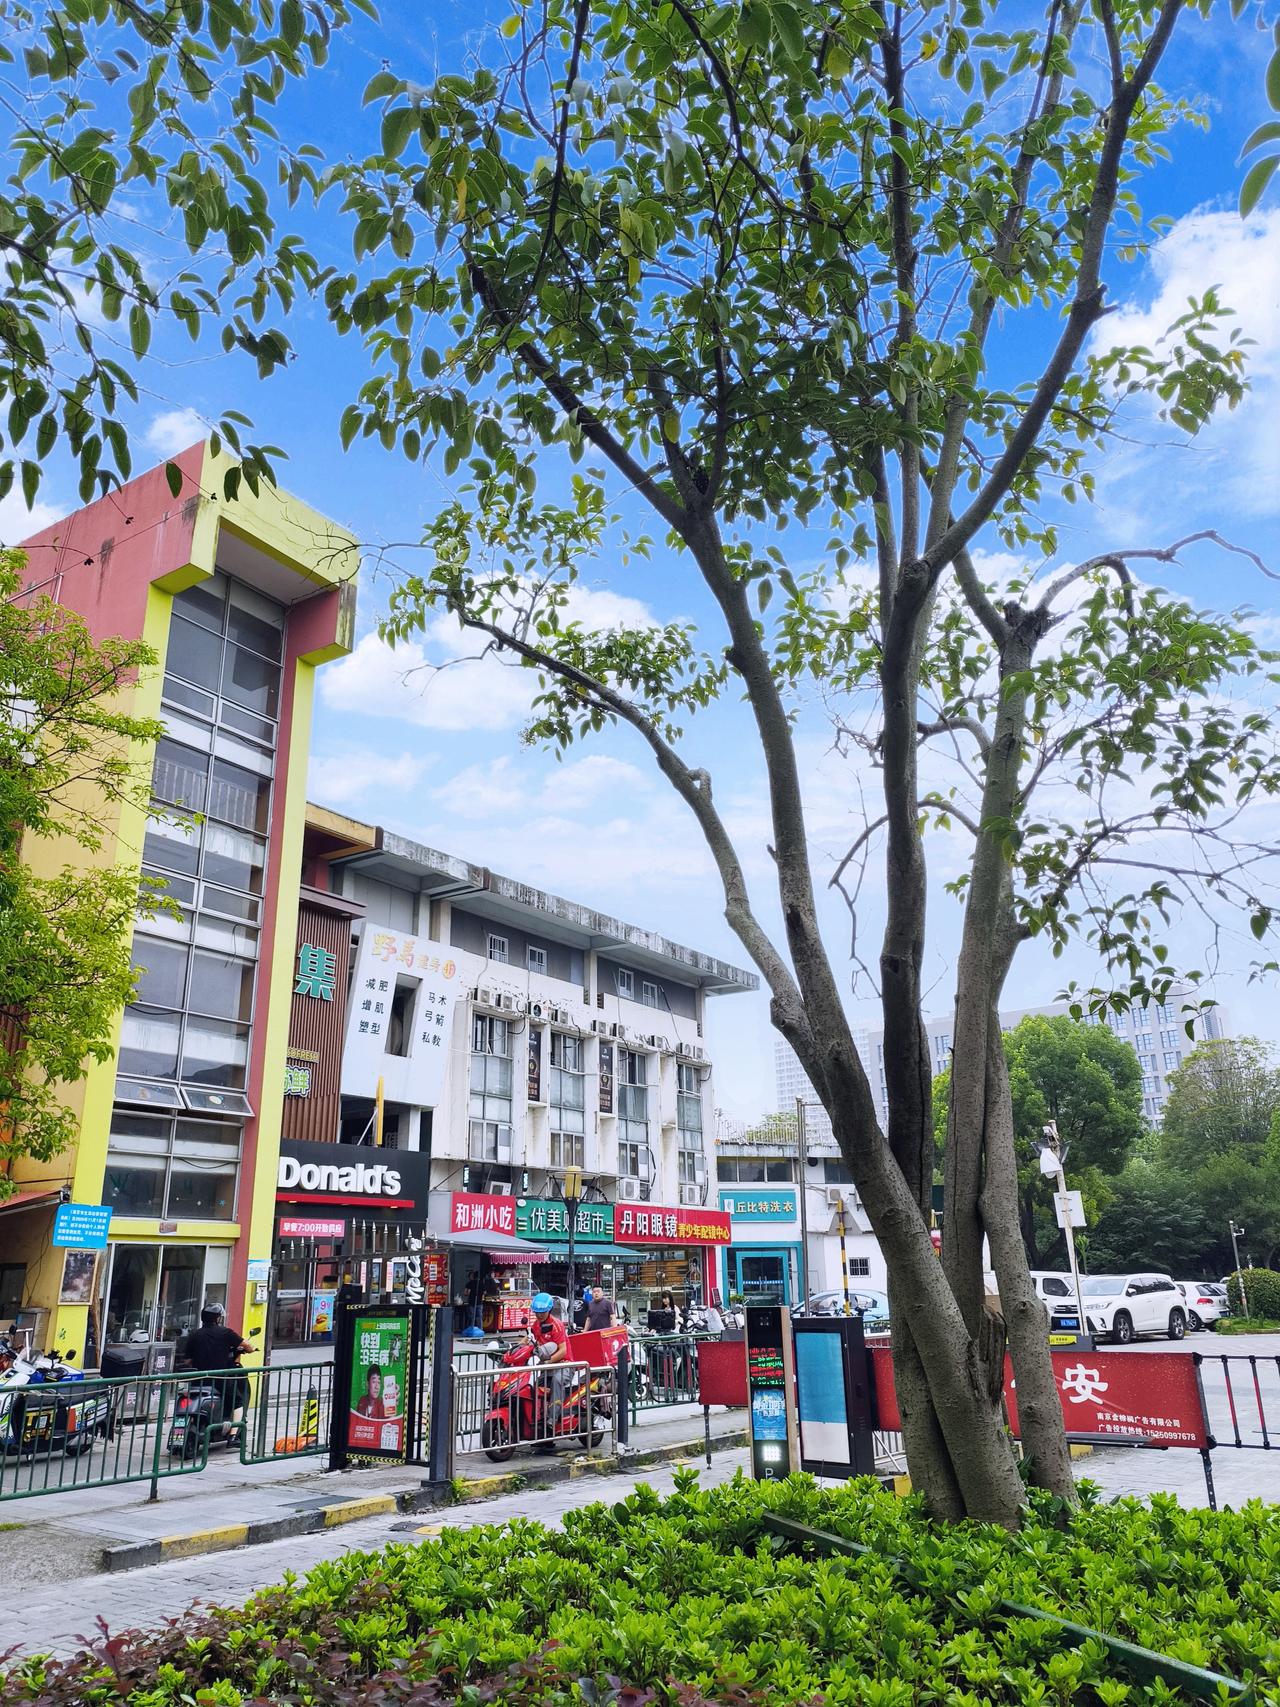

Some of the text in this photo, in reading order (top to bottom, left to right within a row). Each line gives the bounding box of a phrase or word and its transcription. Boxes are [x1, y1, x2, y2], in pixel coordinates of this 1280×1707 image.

[295, 943, 336, 1001] 集
[365, 978, 389, 992] 减肥
[361, 999, 384, 1015] 增肌
[425, 1010, 445, 1027] 弓箭
[358, 1020, 381, 1035] 塑型
[421, 1031, 442, 1047] 私教
[278, 1156, 402, 1196] Donald's
[736, 1201, 794, 1214] 丘比特洗衣
[455, 1203, 513, 1231] 和洲小吃
[620, 1210, 678, 1238] 丹阳眼镜
[678, 1223, 731, 1240] 青少年配镜中心
[1062, 1363, 1109, 1405] 安
